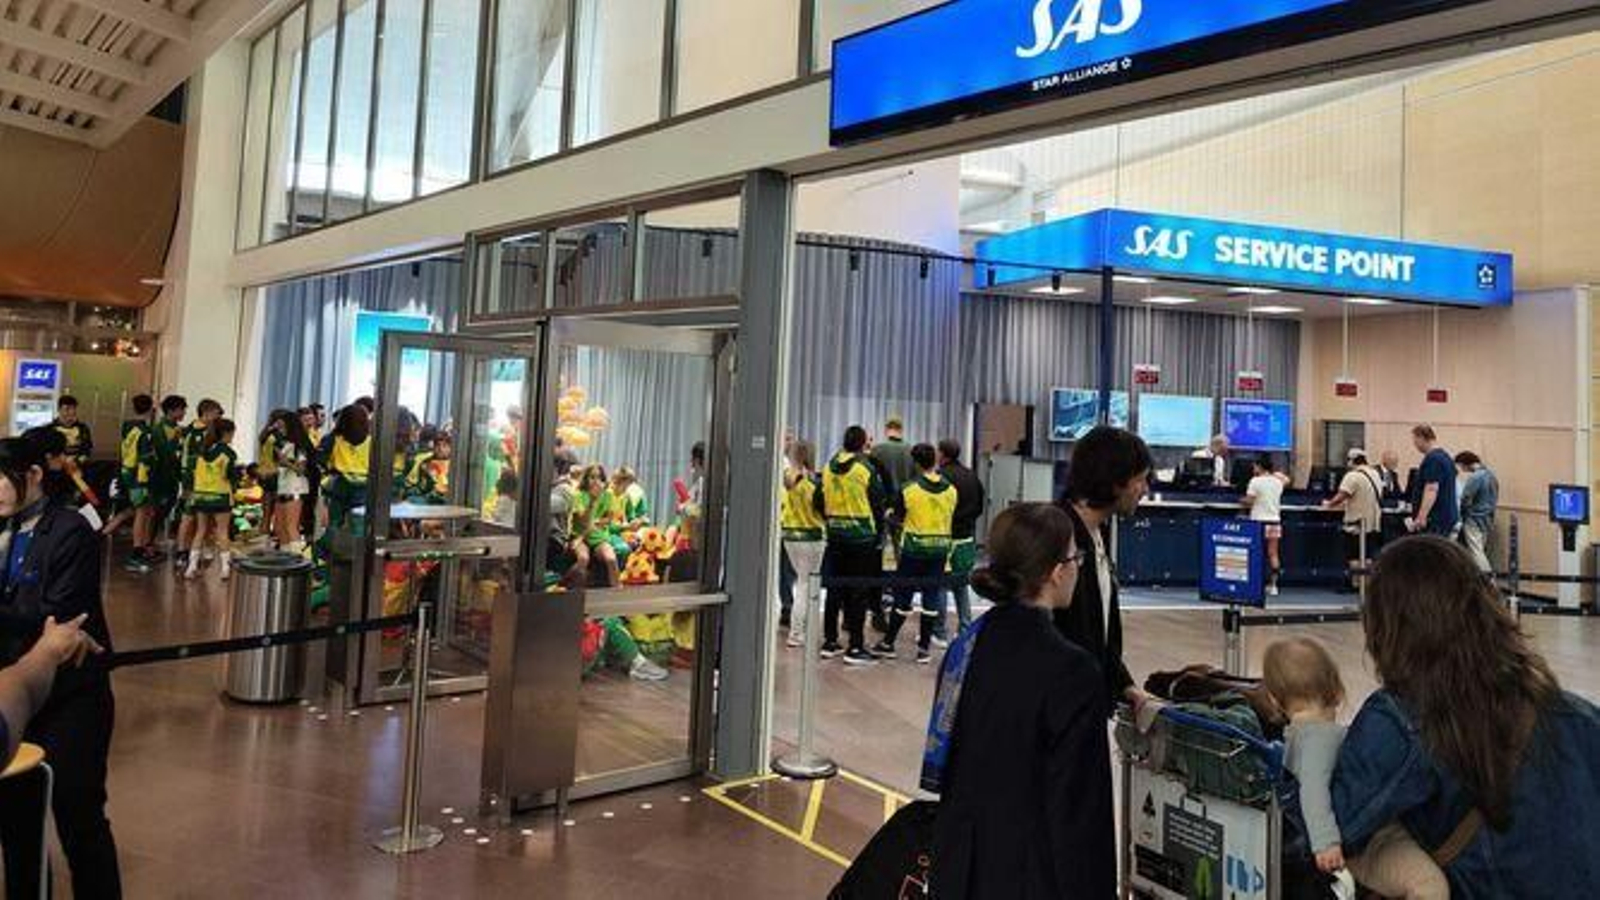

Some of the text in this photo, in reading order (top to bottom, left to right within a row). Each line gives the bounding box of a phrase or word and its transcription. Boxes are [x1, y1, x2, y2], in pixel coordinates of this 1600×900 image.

[1016, 0, 1142, 58] SAS
[1032, 60, 1118, 91] STAR ALLIANCE
[1124, 225, 1416, 281] SAS SERVICE POINT
[23, 367, 52, 380] SAS
